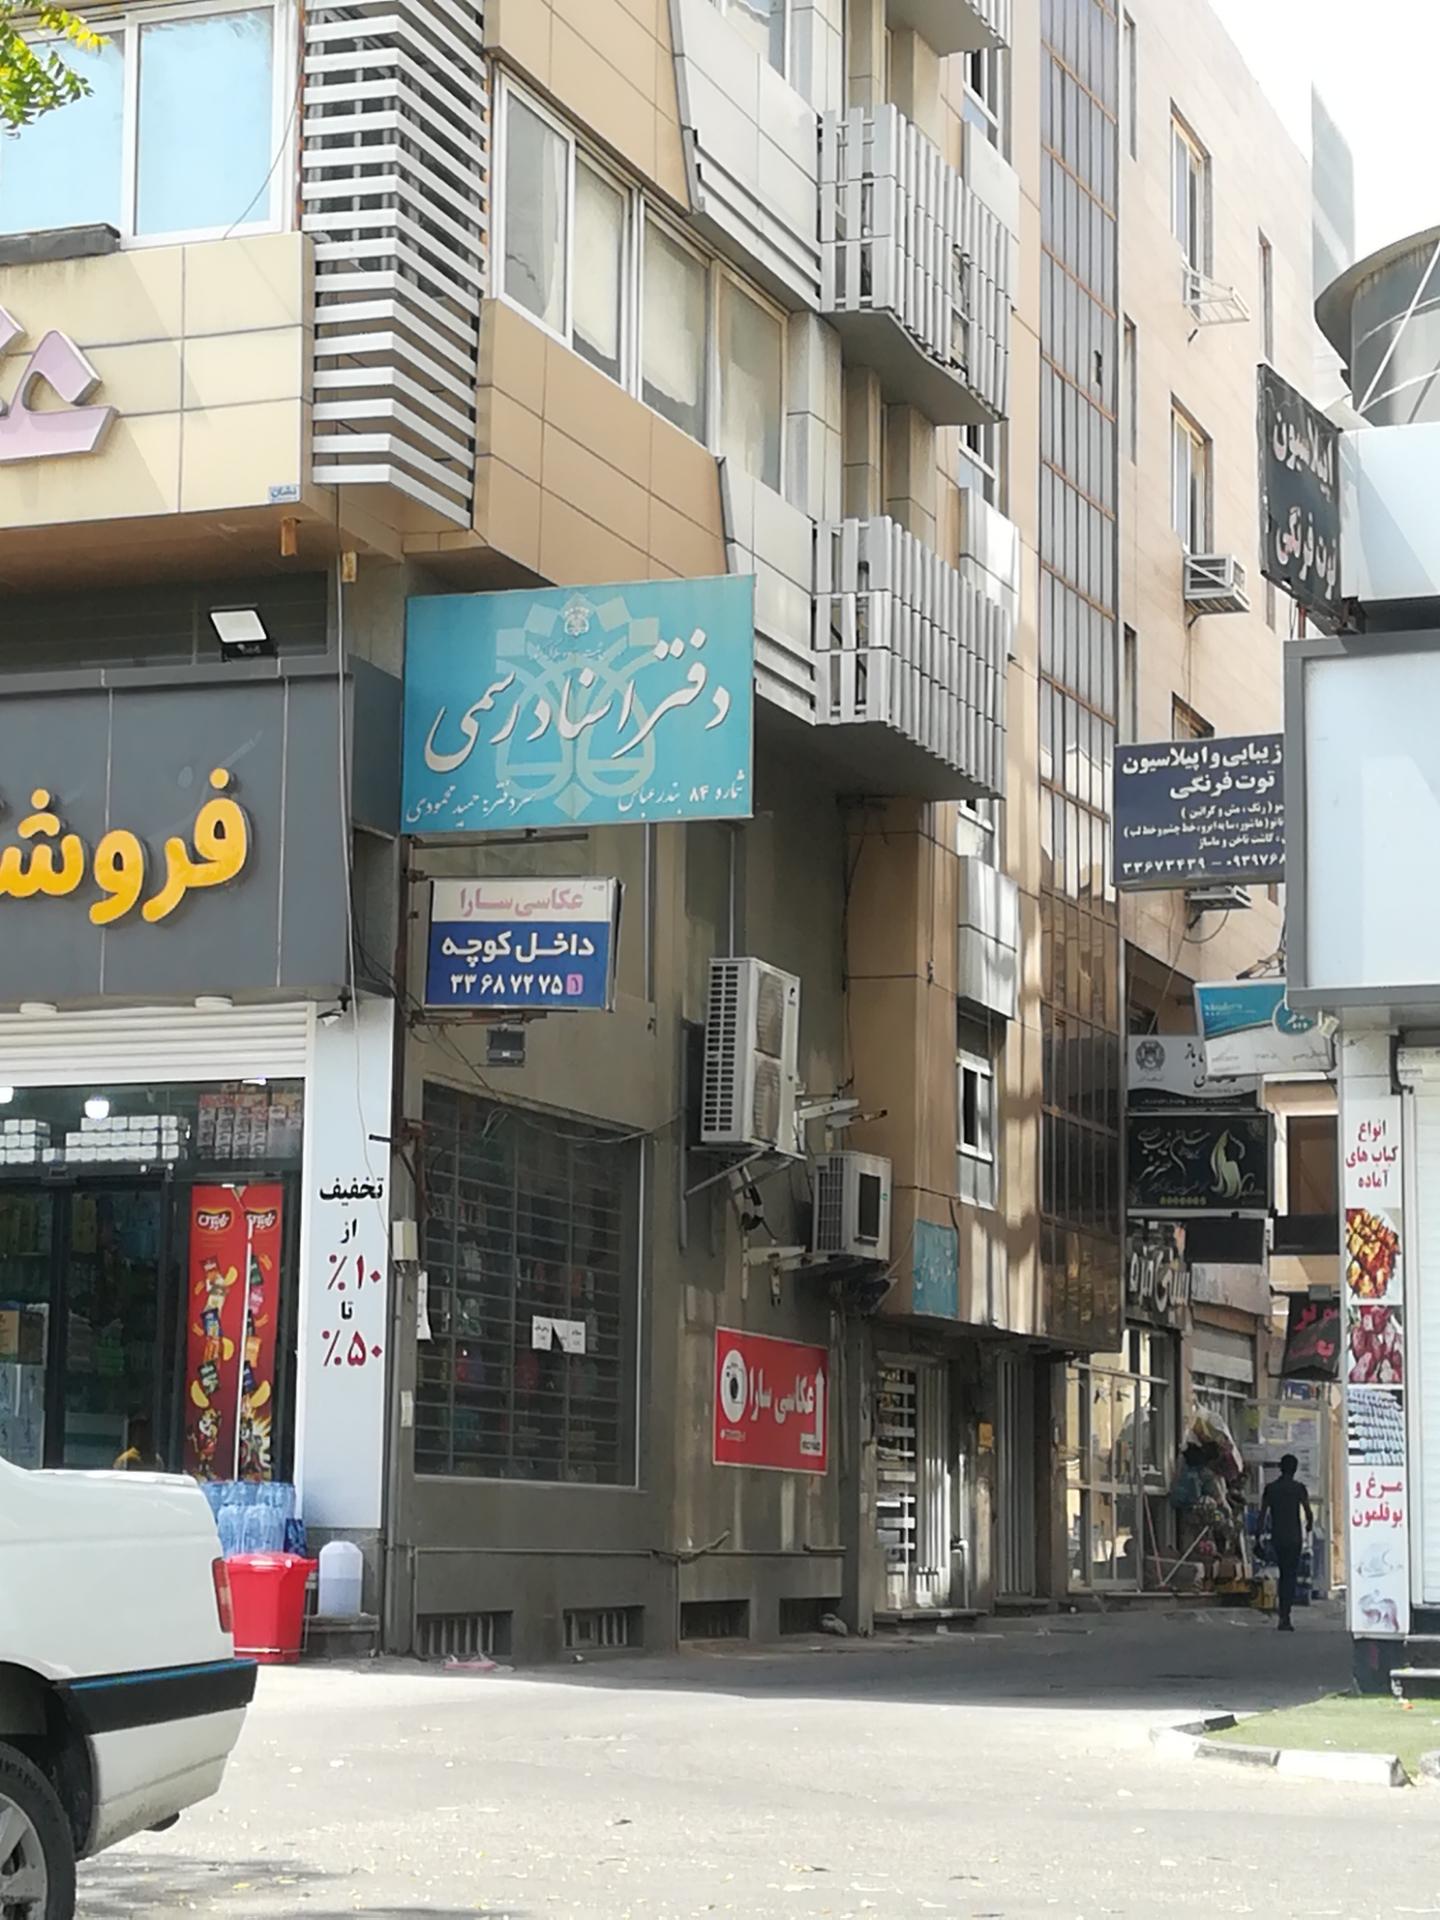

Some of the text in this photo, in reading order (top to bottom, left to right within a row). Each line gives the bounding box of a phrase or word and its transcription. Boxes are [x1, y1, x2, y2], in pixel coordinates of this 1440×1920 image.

[424, 627, 730, 773] دفتر اسناد رسمی
[1122, 742, 1282, 774] زیبایی و اپیلاسیون
[689, 785, 709, 802] ۸۴
[1170, 770, 1275, 799] توت فرنگی
[460, 887, 583, 917] عکاسی سارا
[441, 930, 594, 968] داخل کوچه
[1358, 1119, 1386, 1142] انواع
[1345, 1145, 1398, 1168] کباب های
[319, 1176, 384, 1206] تخفیف
[1358, 1169, 1388, 1189] آماده
[340, 1218, 357, 1244] از
[341, 1301, 354, 1320] تا
[749, 1366, 815, 1425] عکاسی سارا
[1355, 1471, 1403, 1498] مرغ و
[1352, 1501, 1403, 1528] بوقلمون
